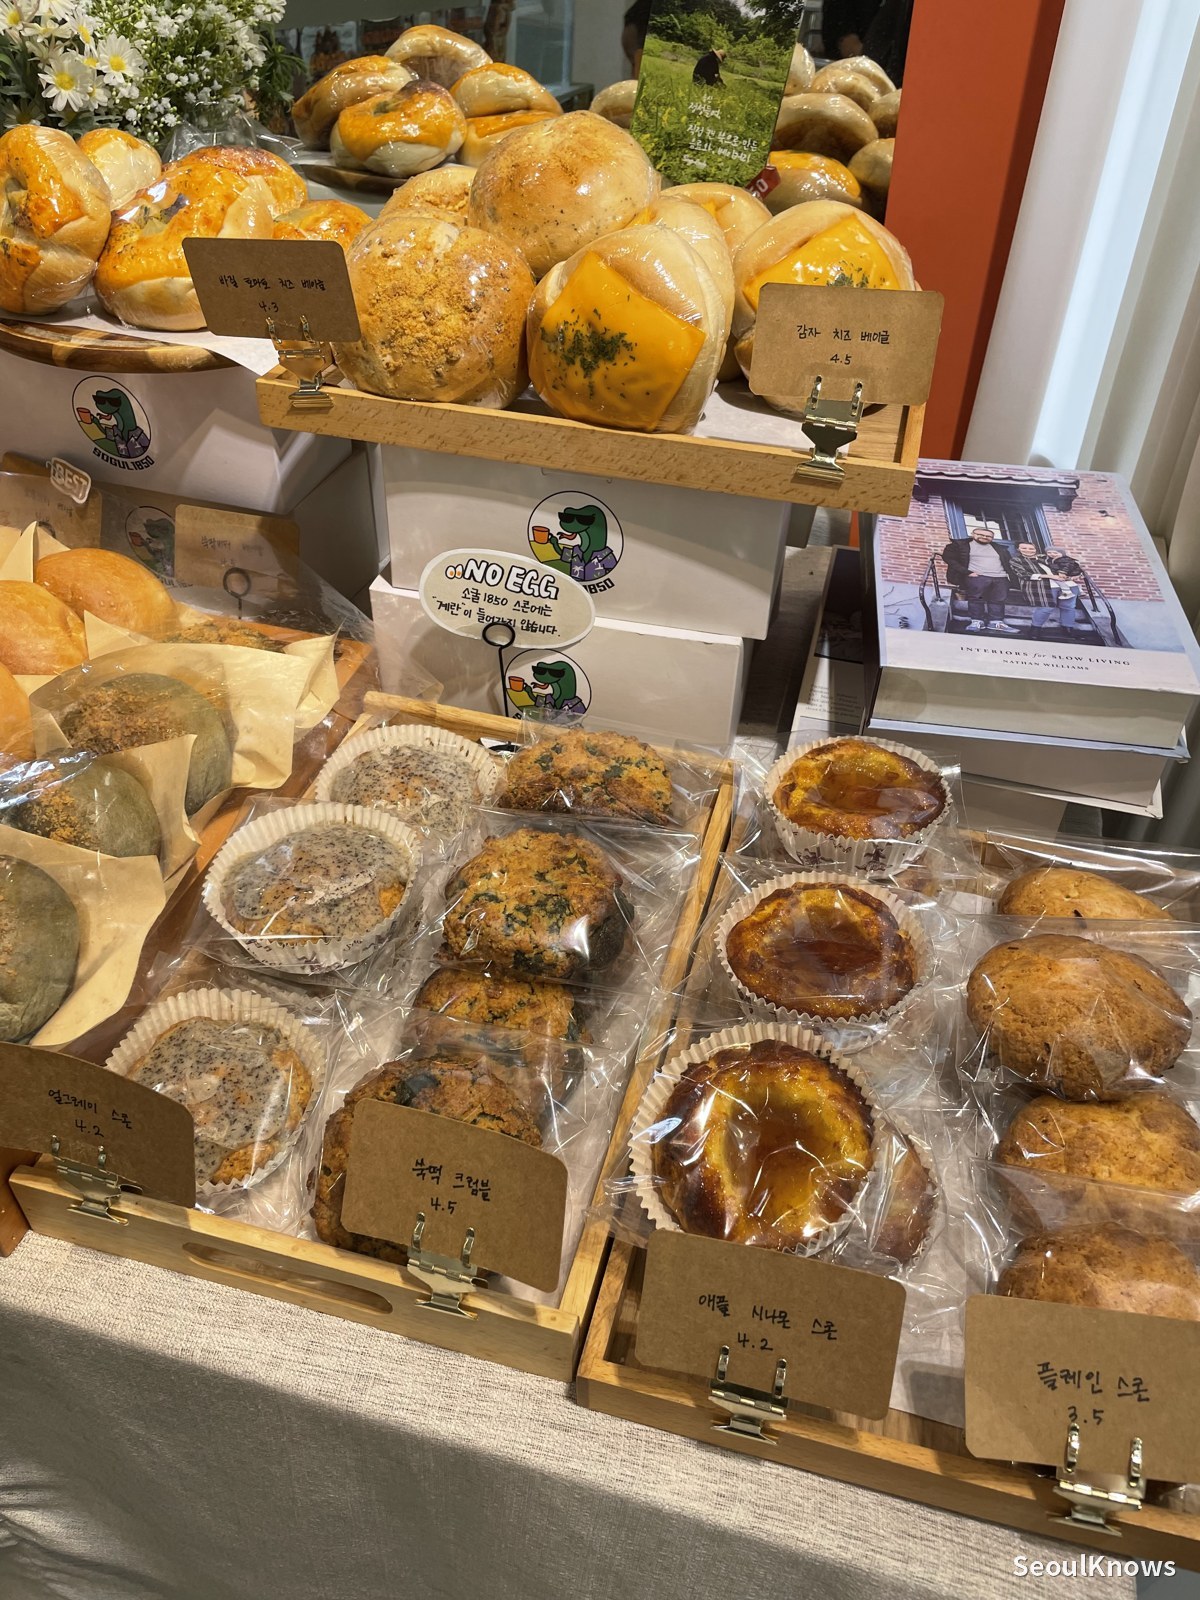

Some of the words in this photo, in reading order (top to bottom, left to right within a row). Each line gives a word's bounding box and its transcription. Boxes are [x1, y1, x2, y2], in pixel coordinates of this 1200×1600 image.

[742, 138, 758, 152] 만든
[278, 277, 295, 290] 치즈
[258, 300, 279, 312] 4.3
[796, 324, 822, 340] 감자
[832, 328, 852, 341] 치즈
[860, 330, 890, 345] 베이글
[829, 353, 852, 366] 4.5
[92, 447, 155, 471] SOGUL1850
[55, 464, 88, 500] BEST
[463, 558, 505, 587] NO
[504, 564, 560, 601] EGG
[461, 586, 481, 605] 소굴
[483, 594, 509, 607] 1850
[512, 599, 553, 618] 스콘에는
[476, 607, 516, 629] 들어가지
[520, 617, 562, 638] 않습니다.
[960, 645, 1029, 658] INTERIORS
[1051, 654, 1084, 663] SLOW
[1088, 657, 1132, 667] LIVING
[1002, 658, 1040, 667] NATHAN
[1043, 662, 1090, 672] WILLIAMS
[48, 1089, 98, 1114] 얼그레이
[111, 1109, 133, 1130] 스콘
[74, 1119, 105, 1138] 4.2
[412, 1158, 443, 1185] 쑥떡
[452, 1173, 491, 1202] 크럼블
[430, 1197, 457, 1214] 4.5
[698, 1294, 731, 1318] 애플
[751, 1305, 791, 1329] 시나몬
[811, 1318, 838, 1341] 스콘
[737, 1332, 774, 1351] 4.2
[1036, 1361, 1103, 1395] 플레인
[1116, 1376, 1151, 1403] 스콘
[1067, 1405, 1105, 1426] 3.5
